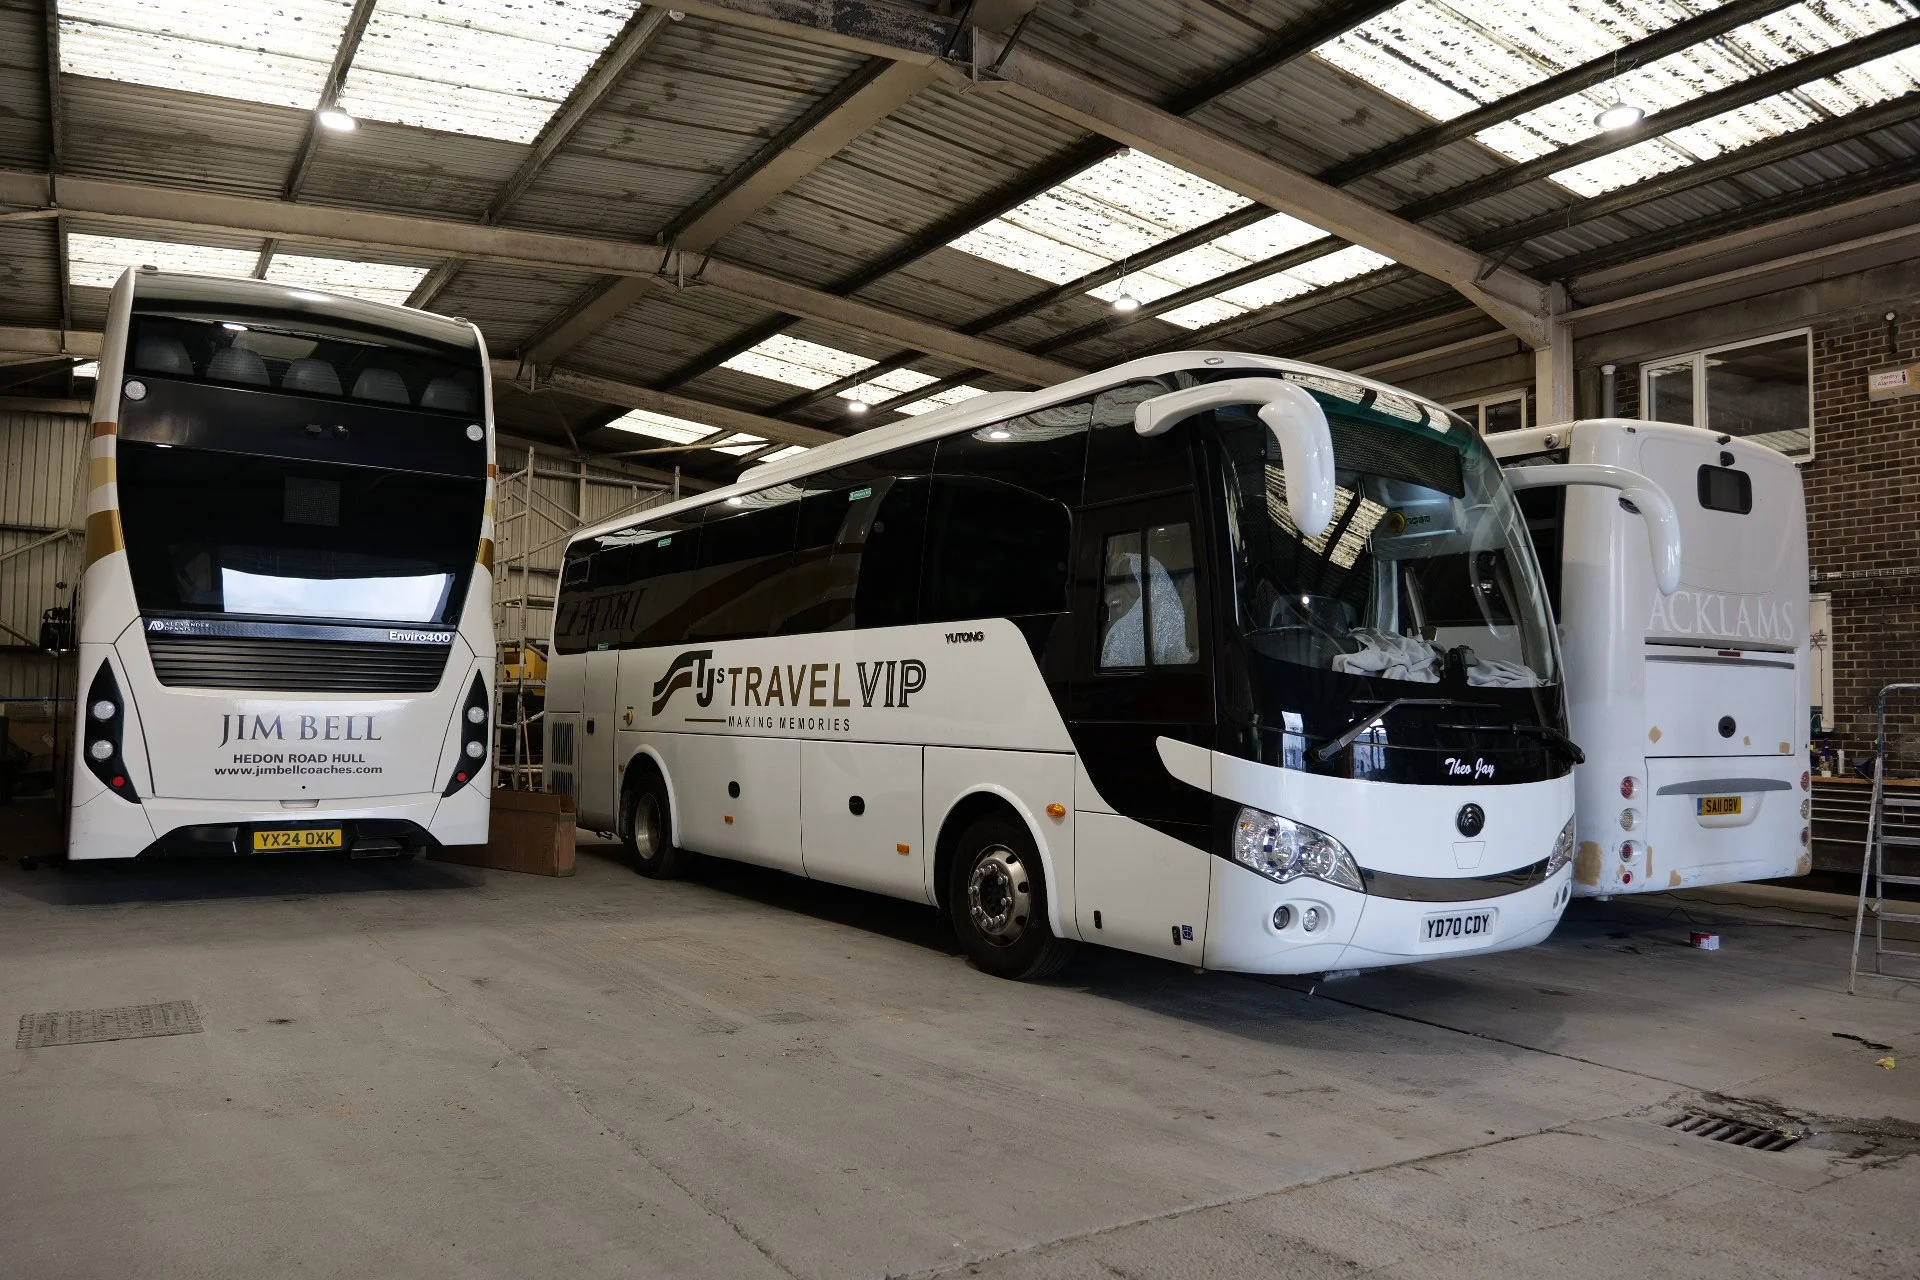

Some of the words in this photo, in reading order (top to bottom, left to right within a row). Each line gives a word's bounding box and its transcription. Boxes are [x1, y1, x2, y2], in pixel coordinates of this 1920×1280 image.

[1645, 588, 1794, 642] ACKLAMS
[389, 630, 451, 642] Enviro400
[945, 630, 985, 644] YUTONG
[727, 662, 851, 707] TRAVEL
[855, 658, 927, 708] VIP
[218, 713, 287, 748] JIM
[297, 714, 382, 741] BELL
[727, 715, 774, 729] MAKING
[779, 716, 851, 731] MEMORIES
[233, 753, 284, 764] HEDON
[288, 753, 328, 763] ROAD
[332, 753, 366, 763] HULL
[214, 765, 383, 777] www.jimbellcoaches.com
[1444, 757, 1472, 776] Theo
[1474, 757, 1495, 780] Jay
[1706, 799, 1722, 813] SA11
[260, 833, 300, 847] YX24
[305, 831, 335, 845] OXK
[1427, 917, 1462, 939] YD70
[1464, 914, 1490, 935] CDY
